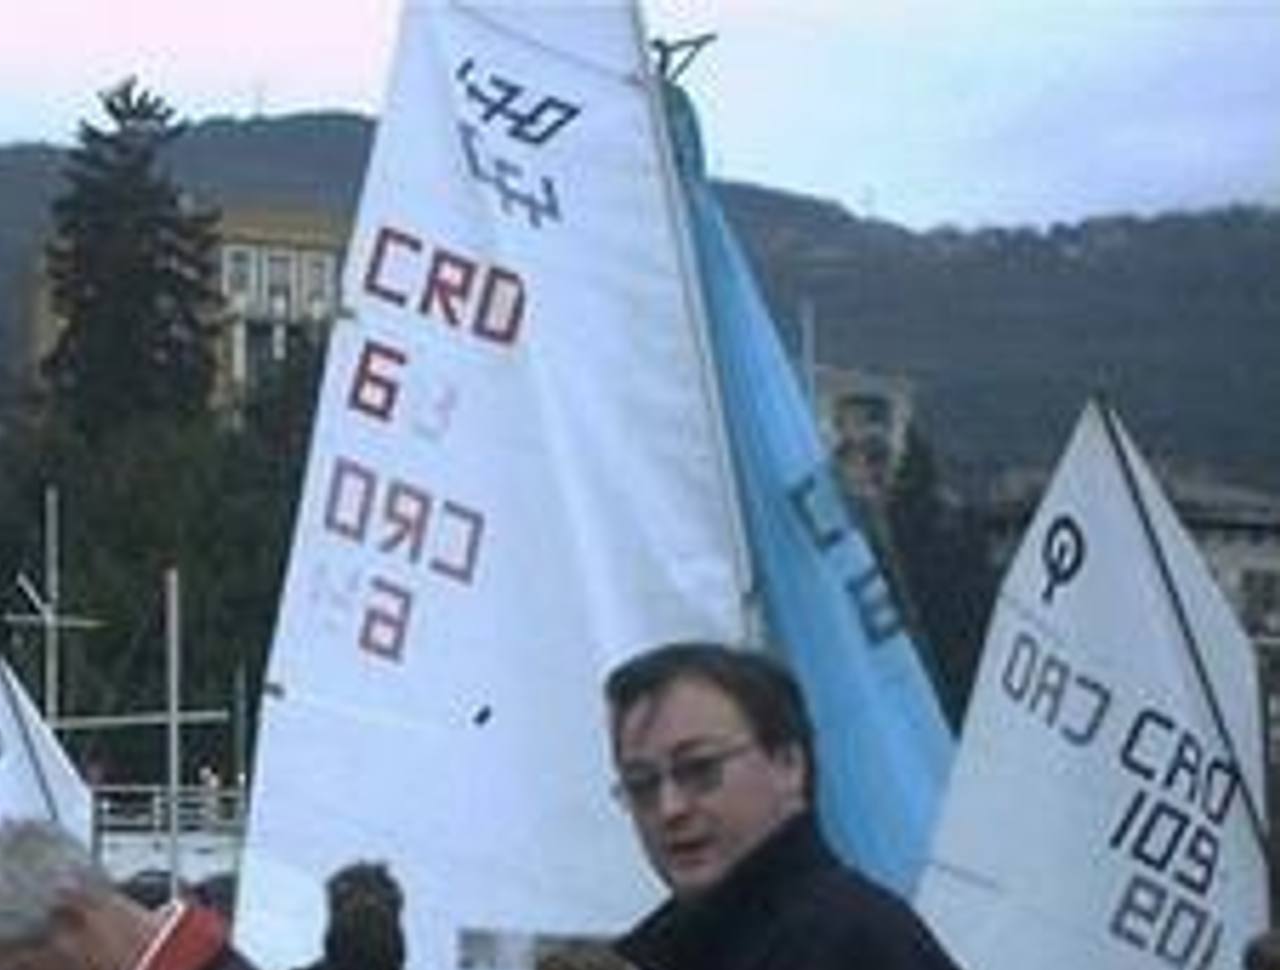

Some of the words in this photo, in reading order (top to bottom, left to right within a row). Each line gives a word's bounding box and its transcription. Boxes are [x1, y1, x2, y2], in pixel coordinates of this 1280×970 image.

[364, 225, 528, 347] CRO
[347, 339, 408, 422] 6
[1120, 707, 1242, 826] CRO
[1109, 789, 1222, 899] 109
